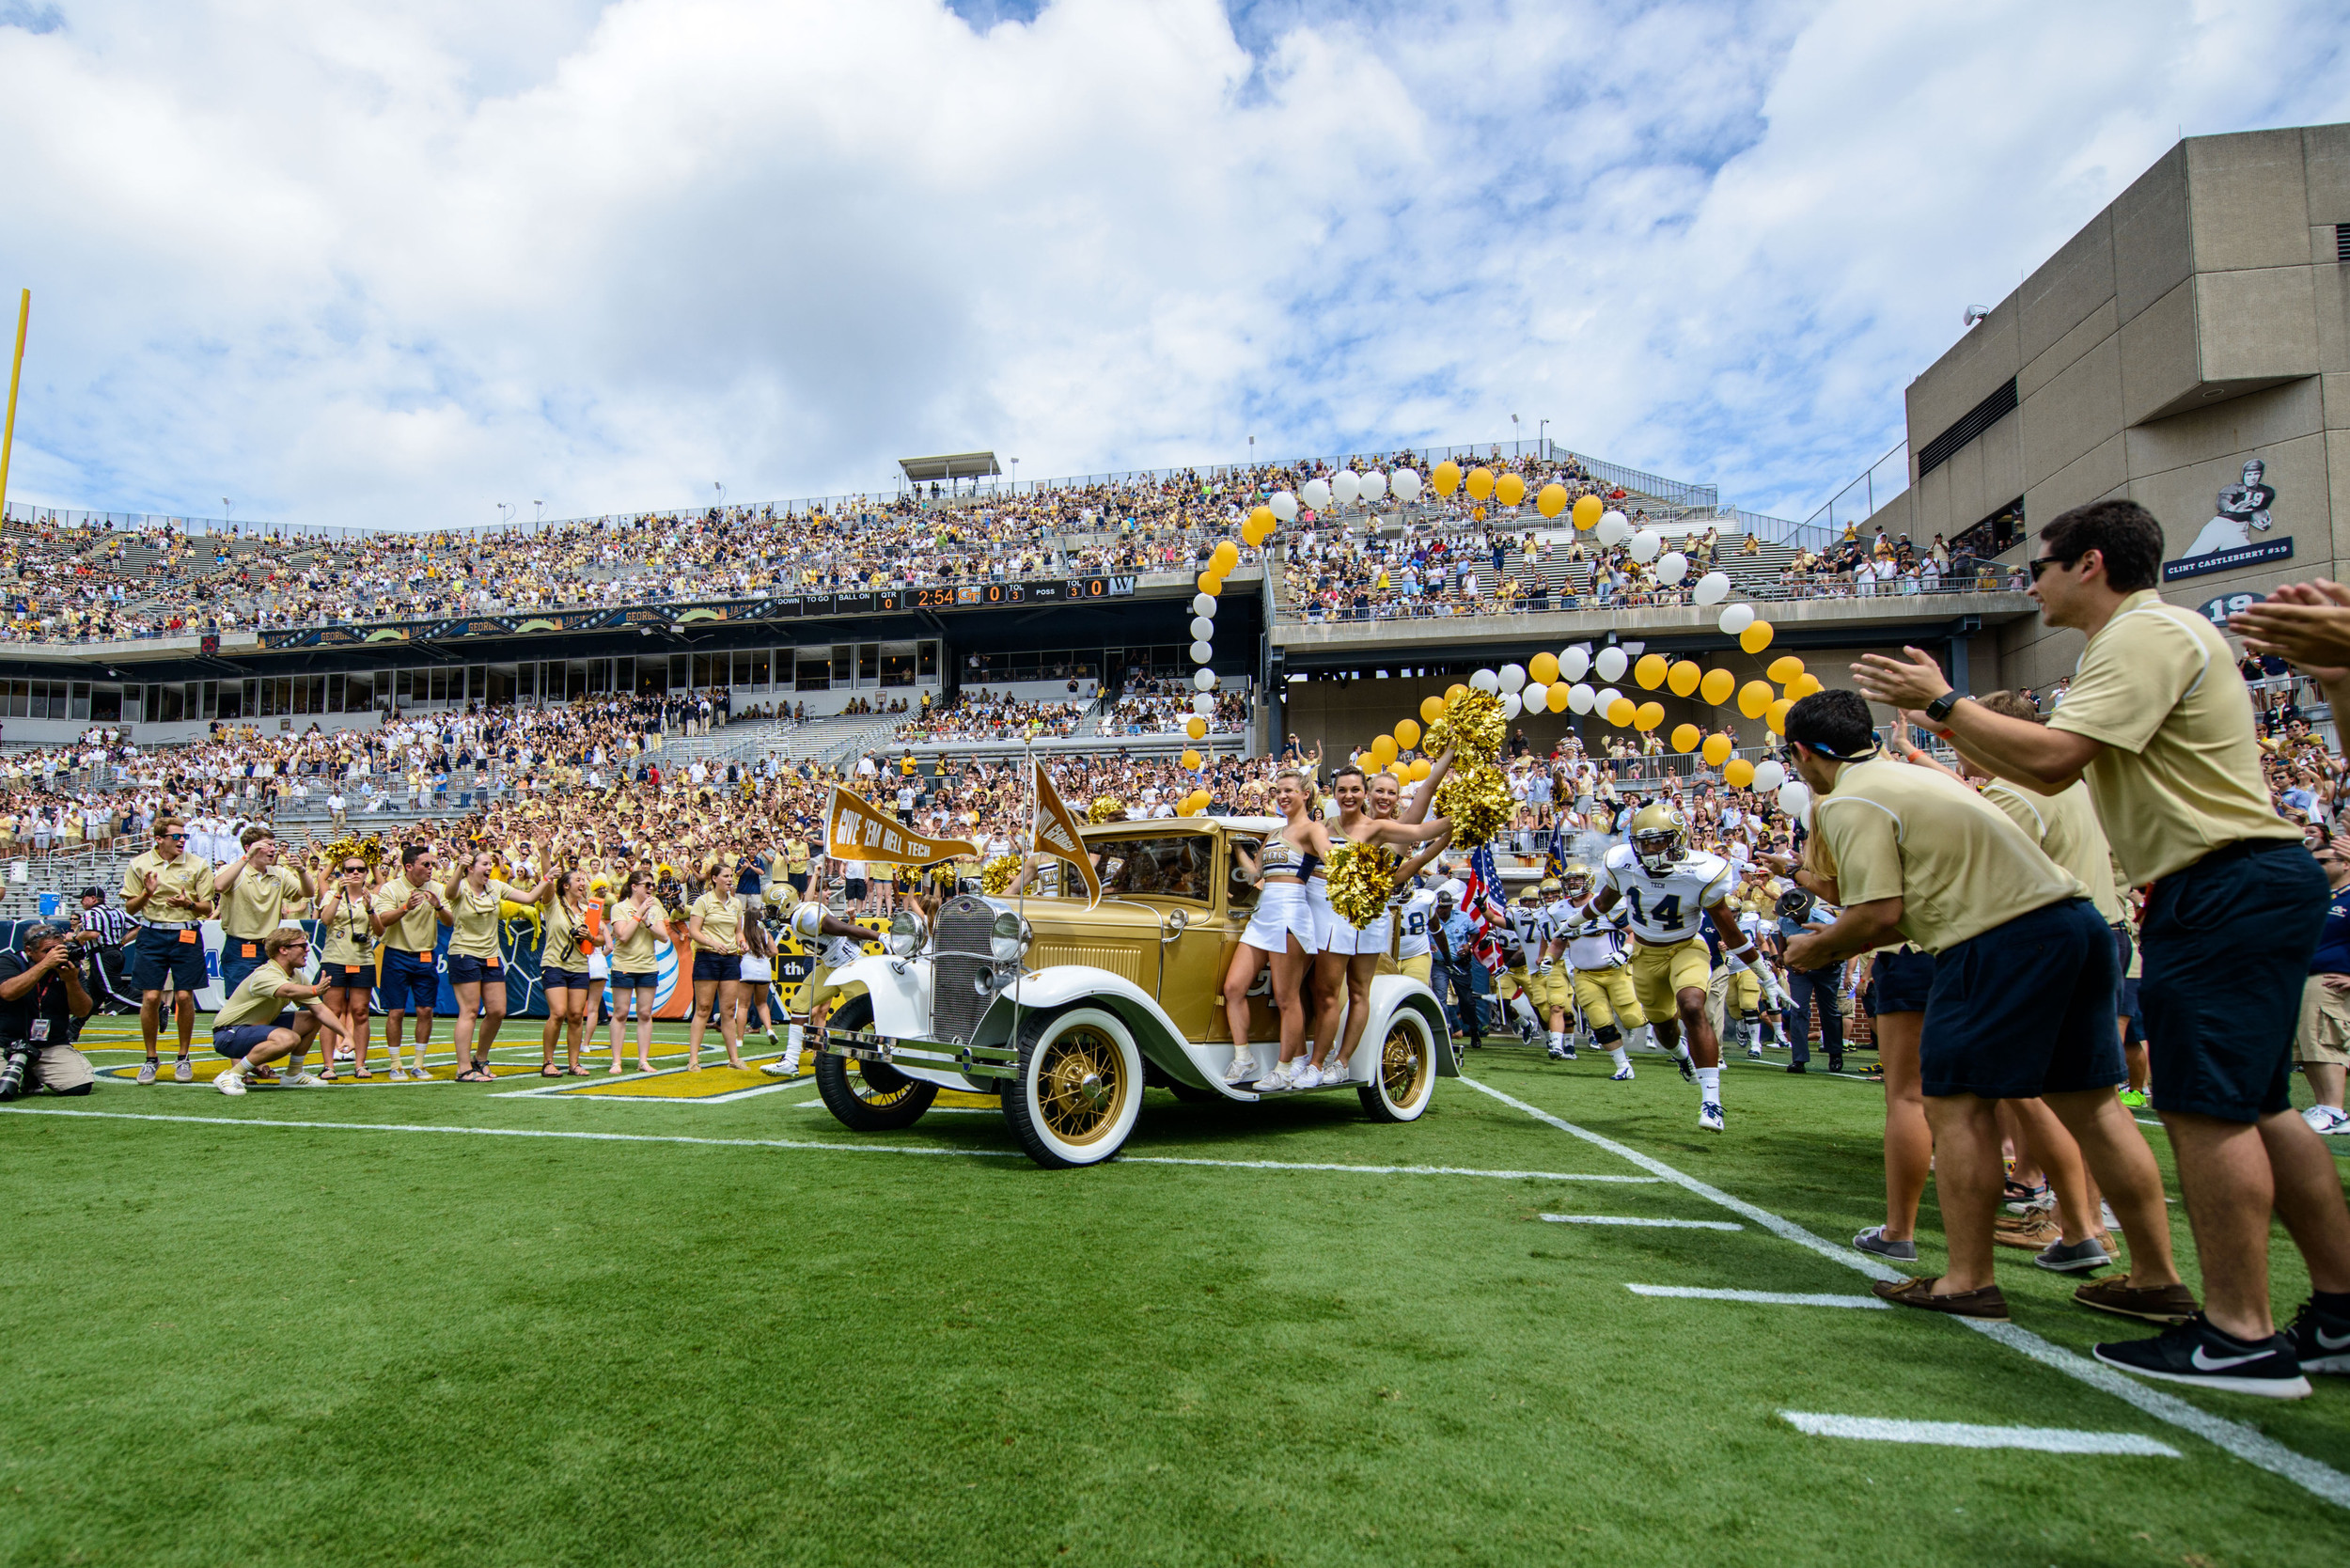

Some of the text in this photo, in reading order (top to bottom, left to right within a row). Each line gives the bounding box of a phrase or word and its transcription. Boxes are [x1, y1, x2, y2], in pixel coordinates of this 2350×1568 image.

[2168, 545, 2287, 574] CLINT CASTLEBERRY #19
[989, 586, 1000, 602] 0
[1012, 591, 1019, 600] 3
[1071, 588, 1077, 596] 3
[1091, 580, 1102, 595] 0
[777, 597, 800, 605] DOWN
[885, 599, 892, 609] 0
[917, 589, 955, 606] 2:54
[202, 637, 215, 652] 25
[836, 808, 863, 845] GIVE
[883, 827, 902, 855] HELL
[907, 840, 932, 857] TECH
[1043, 823, 1077, 853] GEORGIA
[1262, 846, 1290, 864] KETS
[1626, 886, 1684, 932] 14
